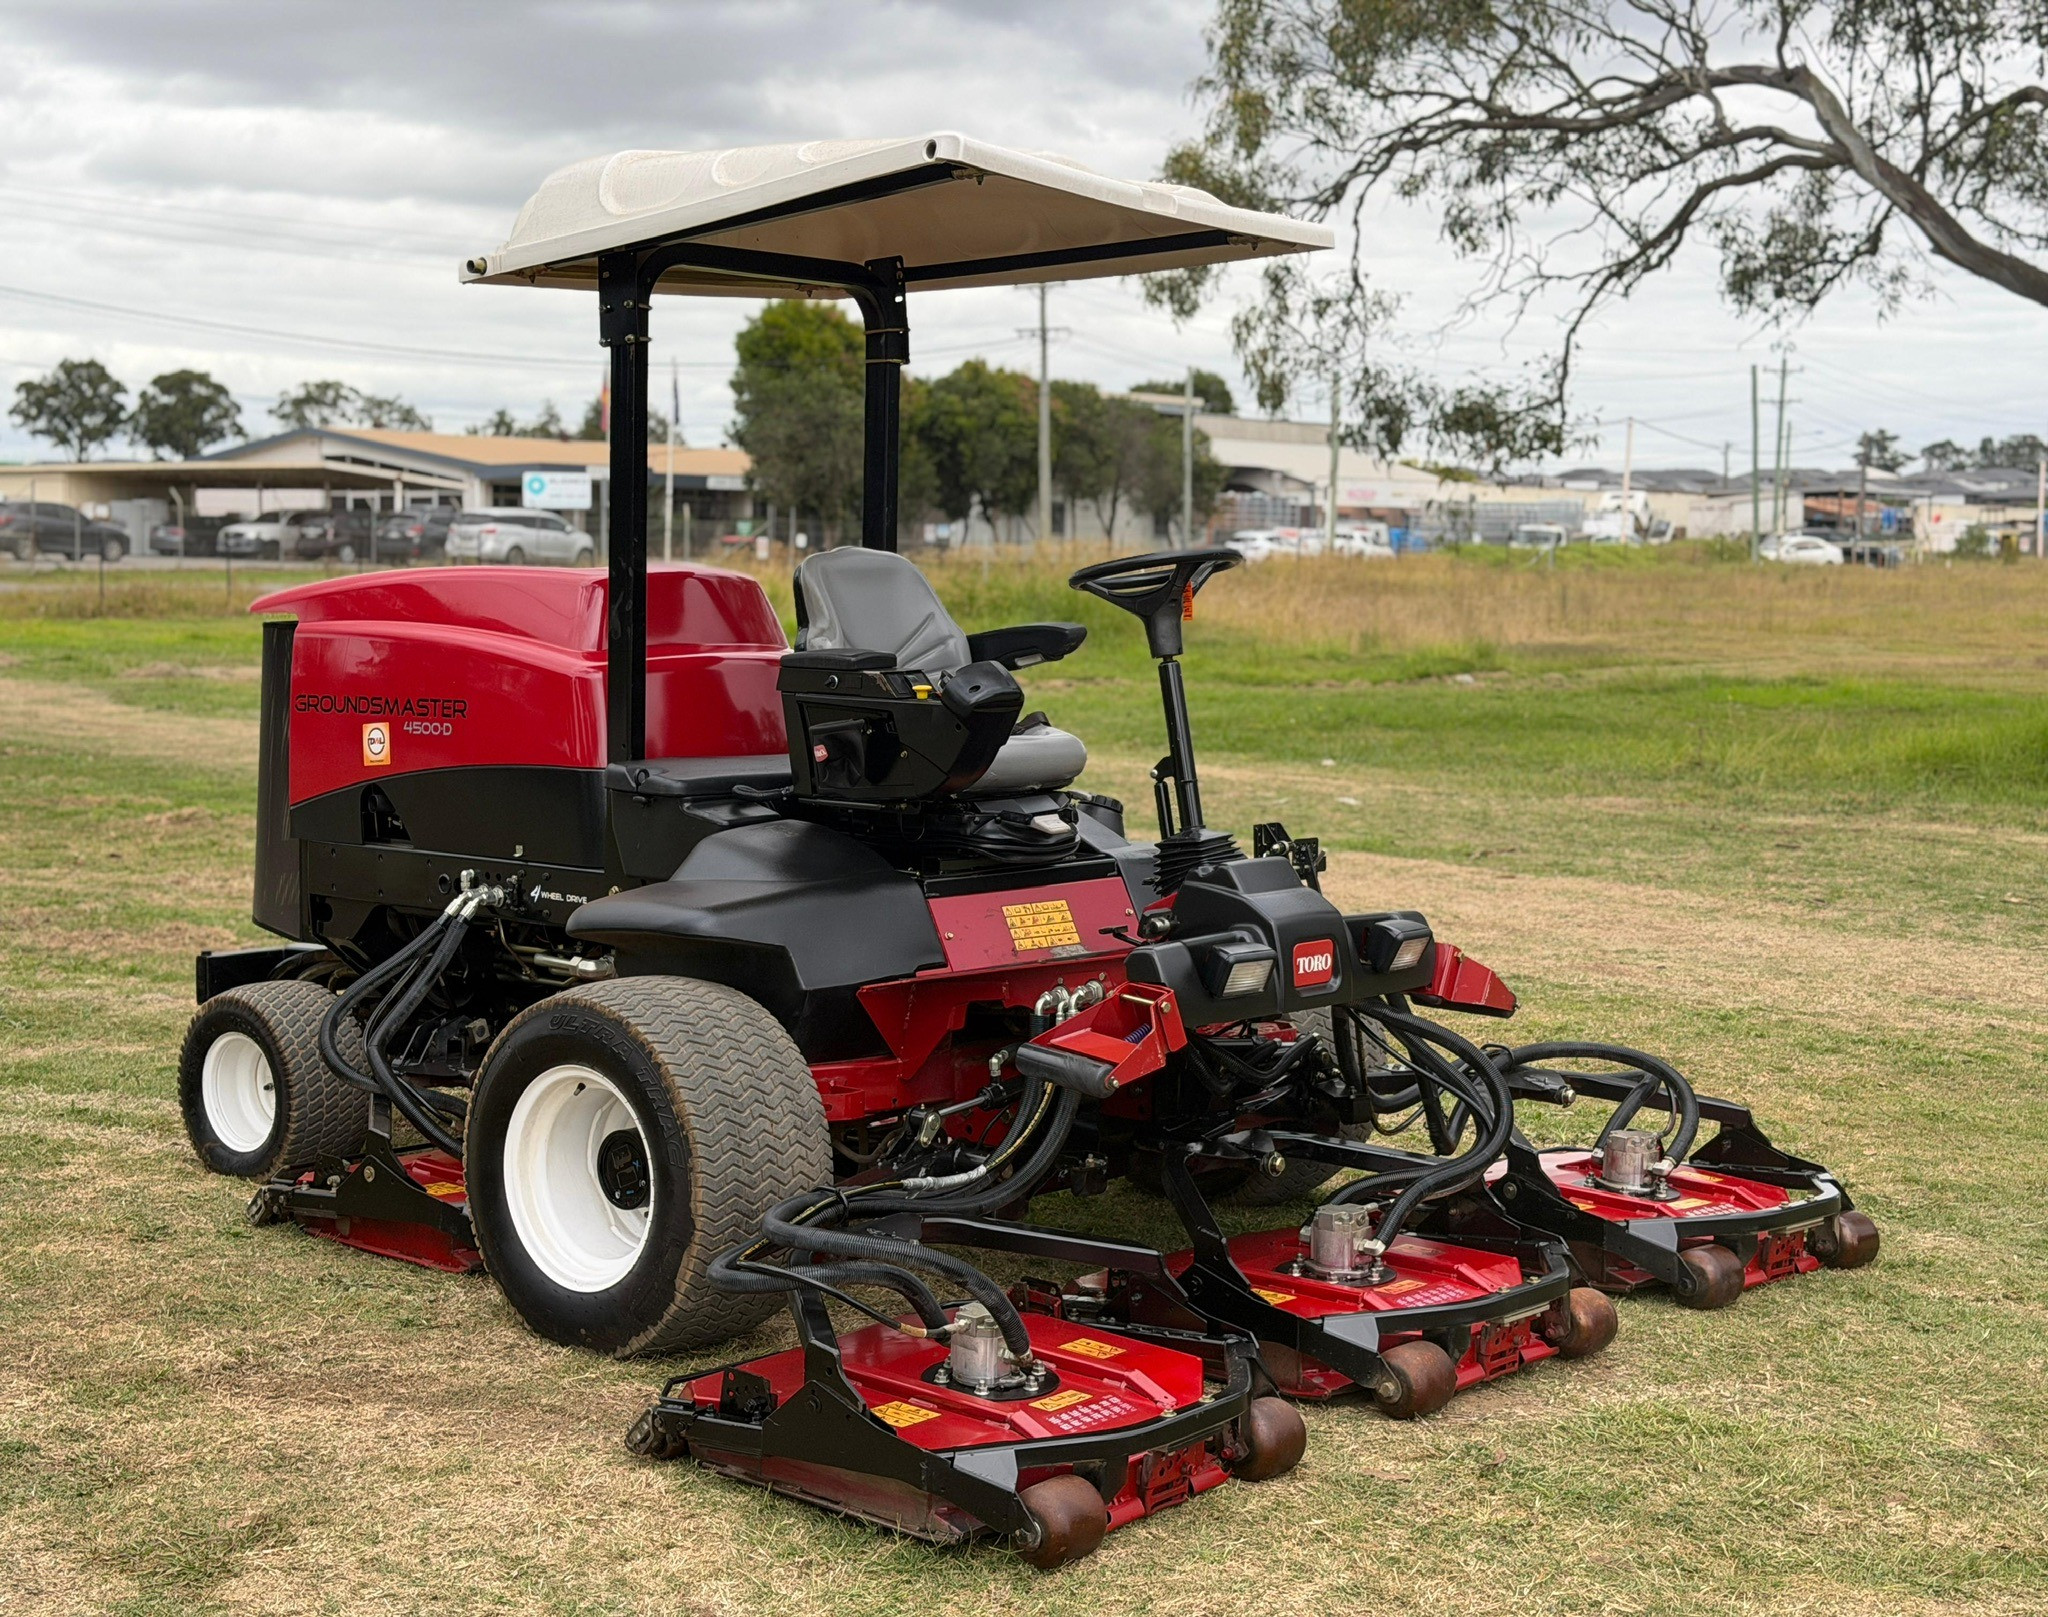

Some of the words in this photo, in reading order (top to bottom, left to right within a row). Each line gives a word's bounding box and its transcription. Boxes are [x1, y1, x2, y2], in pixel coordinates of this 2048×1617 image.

[295, 694, 467, 718] GROUNDSMASTER
[530, 884, 541, 903] 4
[541, 891, 564, 902] WHEEL
[566, 894, 588, 905] DRIVE
[1296, 953, 1332, 974] TORO
[550, 1013, 634, 1061] ULTRA
[636, 1067, 686, 1169] TRAC
